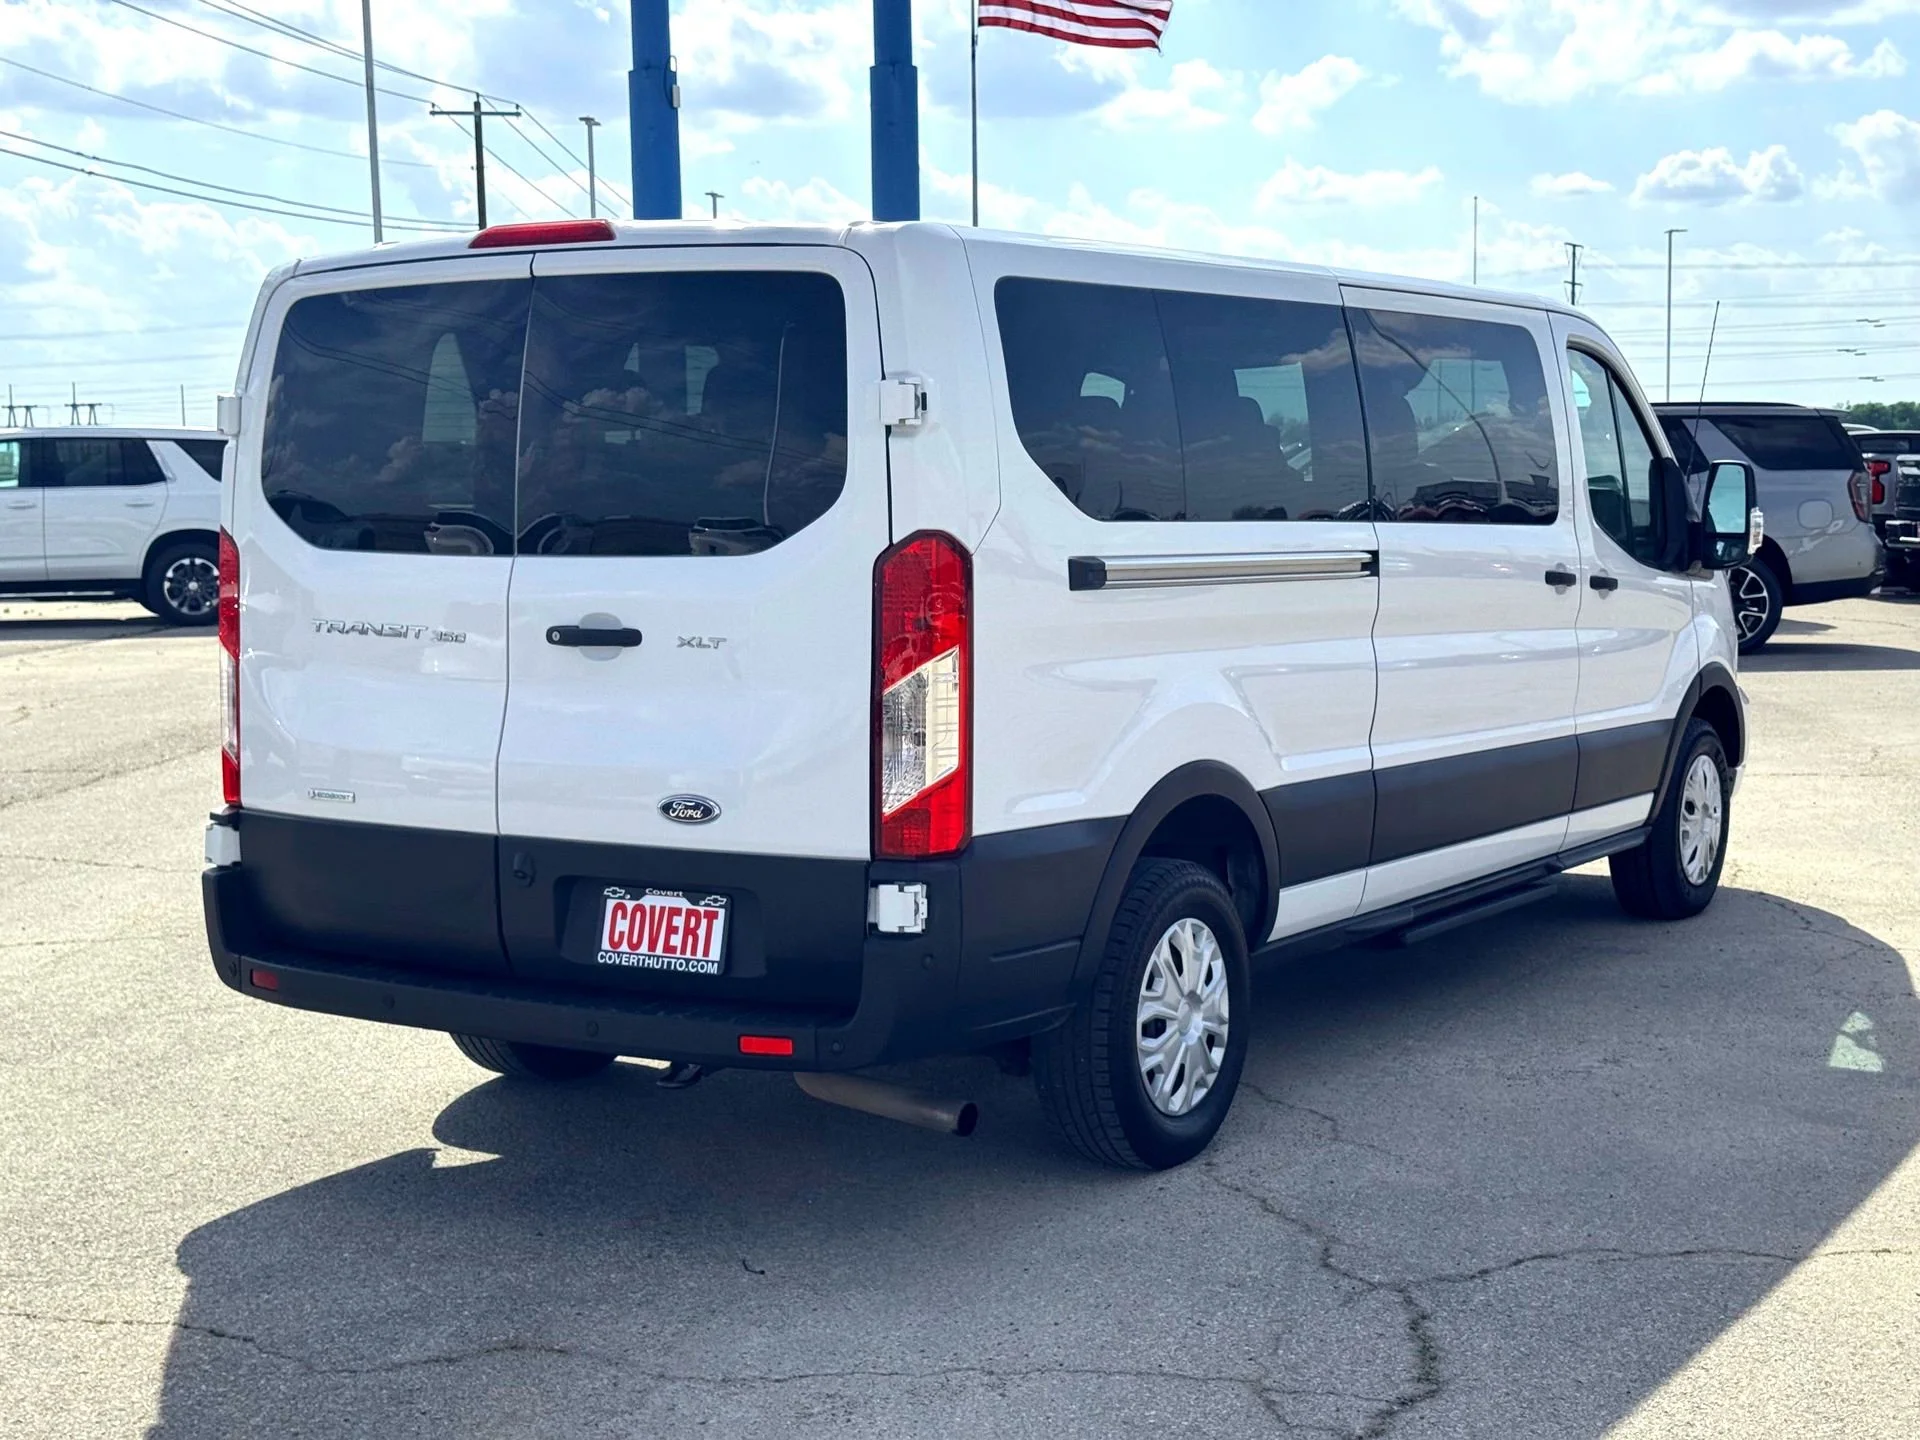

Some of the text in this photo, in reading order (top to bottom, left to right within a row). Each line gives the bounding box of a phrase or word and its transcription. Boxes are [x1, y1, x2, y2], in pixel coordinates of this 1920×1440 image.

[312, 618, 466, 643] TRANSIT 350
[677, 635, 727, 649] XLT
[670, 800, 704, 818] Ford
[645, 888, 684, 897] Covert
[608, 901, 719, 958] COVERT
[597, 951, 718, 974] COVERTHUTTO.COM
